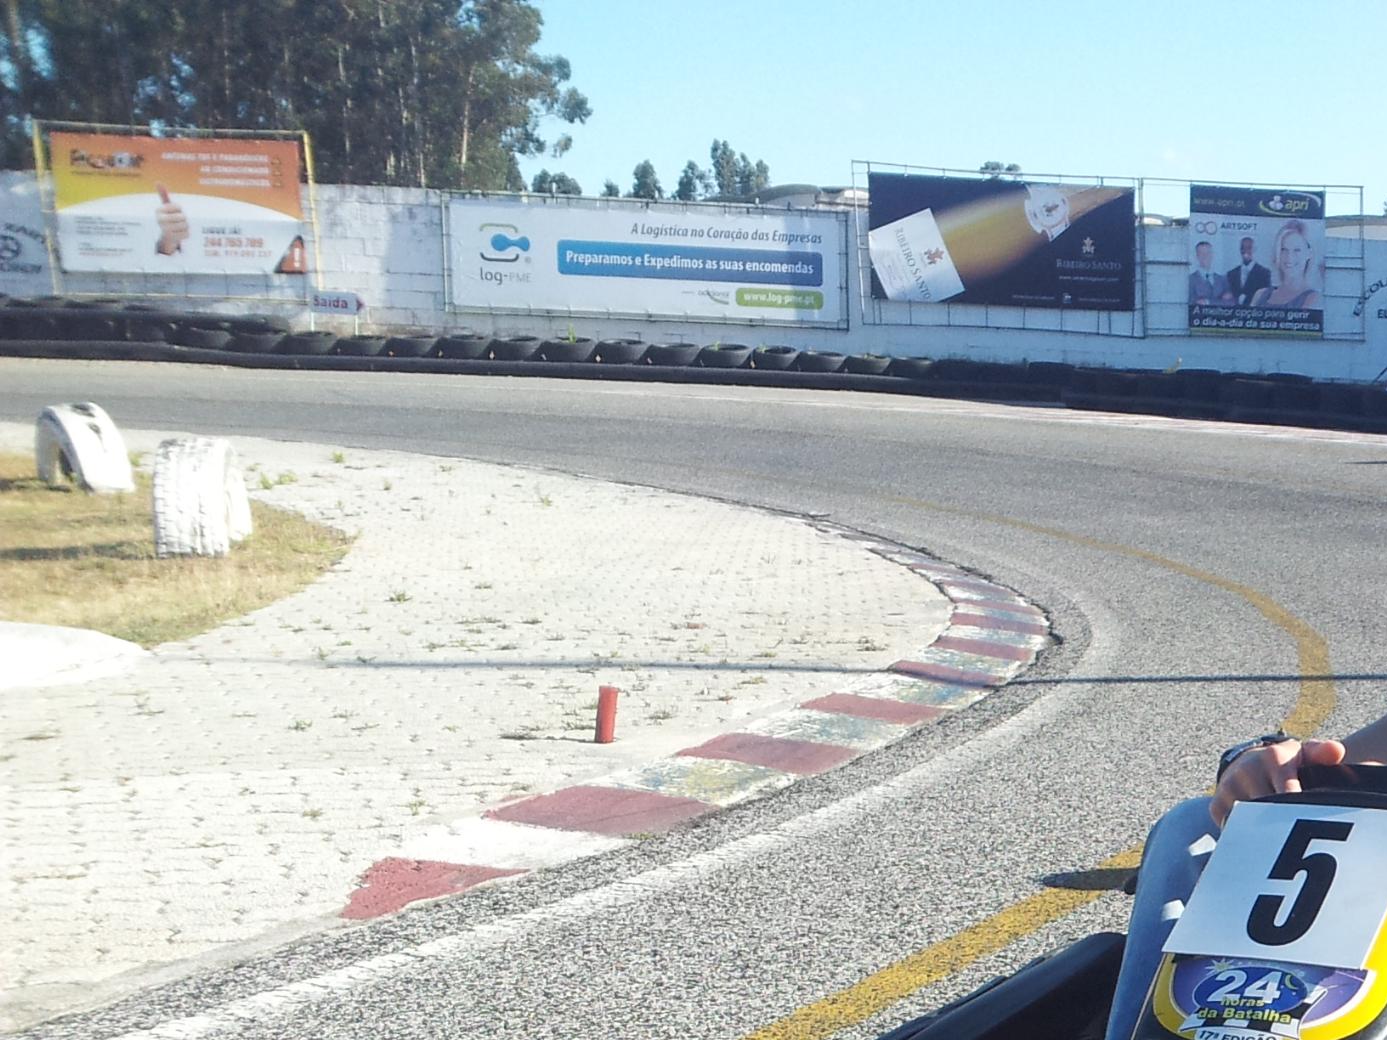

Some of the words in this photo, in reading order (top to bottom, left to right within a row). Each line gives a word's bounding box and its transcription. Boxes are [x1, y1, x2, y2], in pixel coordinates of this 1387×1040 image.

[1284, 198, 1310, 212] apri
[1220, 221, 1258, 231] ARTSOFT
[630, 223, 639, 235] A
[641, 223, 689, 239] Logística
[690, 227, 705, 238] no
[706, 226, 749, 242] Coração
[751, 227, 770, 241] das
[772, 229, 823, 246] Empresas
[566, 250, 633, 266] Preparamos
[634, 256, 645, 266] e
[644, 254, 704, 270] Expedimos
[705, 259, 718, 269] as
[719, 260, 744, 271] suas
[745, 261, 815, 275] encomendas
[1193, 305, 1200, 315] A
[1202, 306, 1233, 317] melhor
[1264, 309, 1285, 319] para
[1245, 319, 1258, 328] da
[1260, 320, 1278, 329] sua
[1279, 321, 1321, 332] empresa
[1246, 818, 1355, 947] 5
[1206, 969, 1283, 1004] 24
[1220, 994, 1266, 1007] horas
[1196, 1007, 1218, 1019] da
[1222, 1008, 1293, 1024] Batalha
